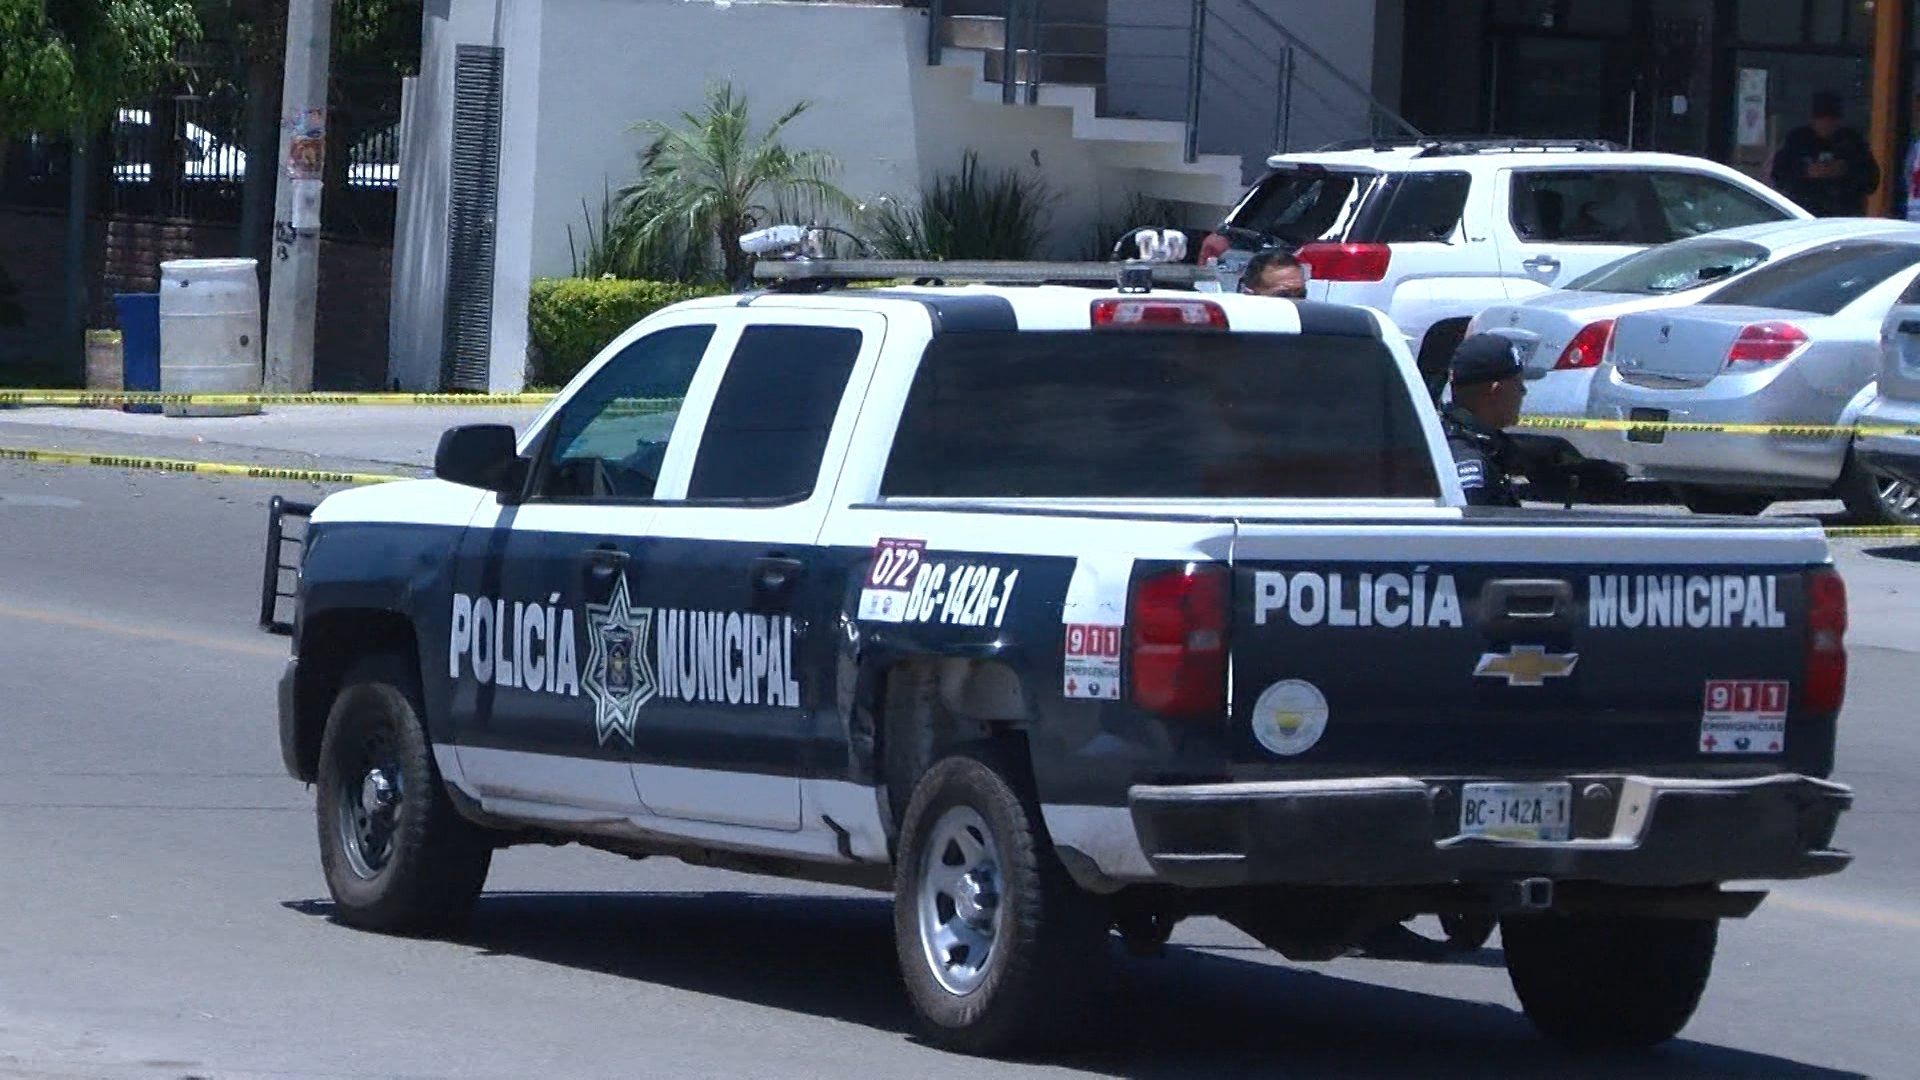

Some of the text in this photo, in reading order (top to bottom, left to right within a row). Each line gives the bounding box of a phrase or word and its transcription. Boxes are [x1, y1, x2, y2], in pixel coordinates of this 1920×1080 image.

[872, 547, 920, 587] 072
[904, 562, 1020, 628] BC-142A-1
[1254, 565, 1786, 629] POLICÍA MUNICIPAL
[449, 592, 800, 708] POLICÍA MUNICIPAL
[1070, 628, 1116, 653] 911
[1711, 686, 1780, 709] 911
[1465, 798, 1565, 826] BC-142A-1
